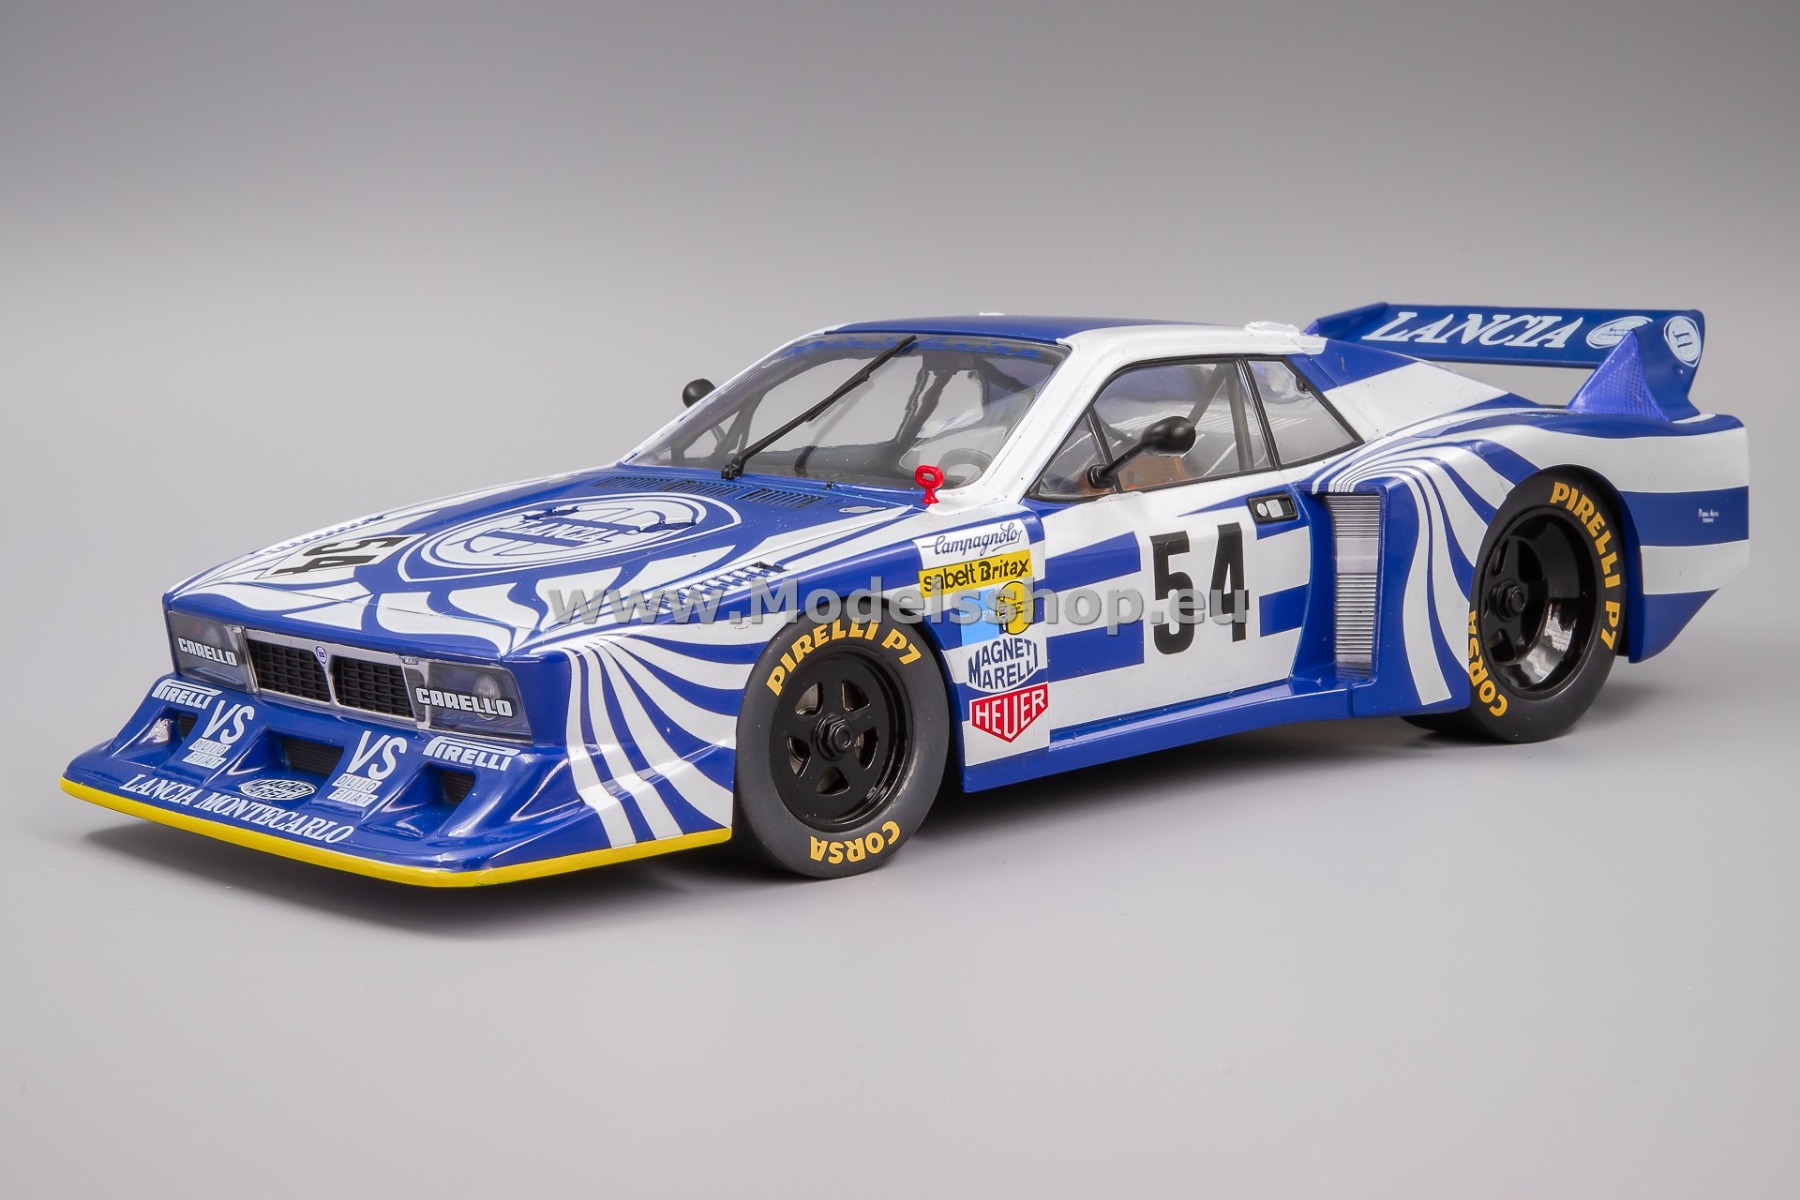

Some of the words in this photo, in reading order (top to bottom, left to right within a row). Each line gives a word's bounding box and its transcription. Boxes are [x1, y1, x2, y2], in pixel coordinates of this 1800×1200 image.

[1361, 312, 1583, 348] LANCIA
[499, 520, 619, 545] LANCIA
[922, 522, 1023, 557] Campagnolo
[271, 536, 412, 575] 54
[1549, 481, 1621, 588] PIRELLI
[1601, 600, 1621, 650] P7
[923, 562, 976, 592] sabelt
[979, 559, 1029, 583] Britax
[1151, 522, 1250, 655] 54
[178, 637, 238, 667] CARELLO
[766, 617, 879, 697] PIRELLI
[881, 628, 922, 665] P7
[968, 638, 1038, 675] MAGNETI
[968, 653, 1038, 689] MARELLI
[151, 678, 223, 710] PIRELLI
[415, 687, 513, 717] CARELLO
[202, 700, 255, 745] VS
[975, 688, 1046, 740] HEUER
[346, 730, 408, 780] VS
[422, 735, 521, 772] PIRELLI
[119, 774, 202, 805] LANCIA
[193, 792, 355, 844] MONTECARLO
[810, 820, 901, 865] CORSA
